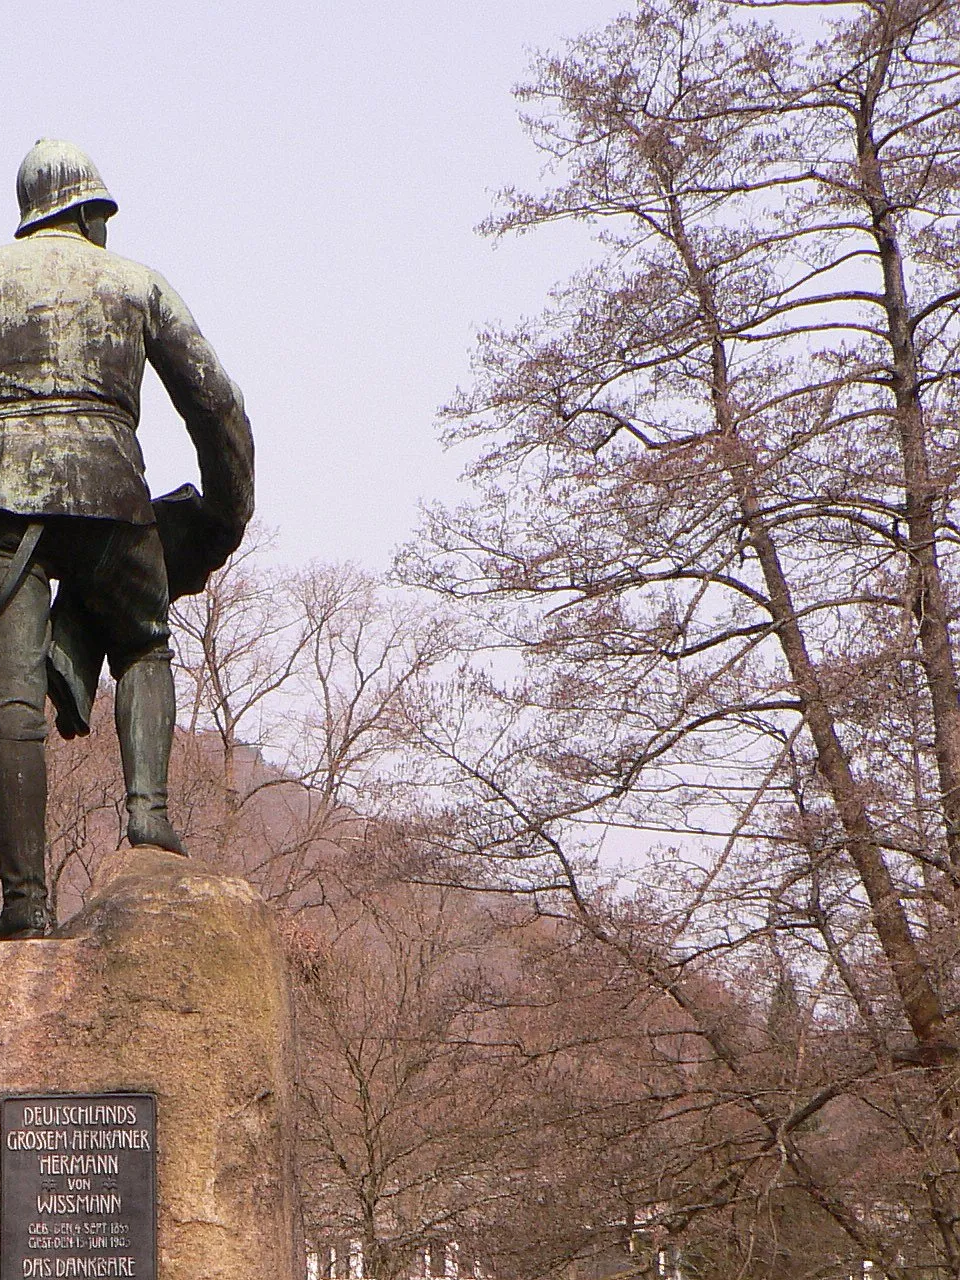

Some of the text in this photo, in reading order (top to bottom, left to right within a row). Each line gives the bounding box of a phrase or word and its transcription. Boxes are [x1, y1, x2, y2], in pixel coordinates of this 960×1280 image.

[23, 1105, 137, 1126] DEUTSCHLANDS
[72, 1130, 150, 1151] AFRIKANER
[40, 1154, 119, 1174] HERMANN
[67, 1178, 91, 1190] VON
[37, 1194, 121, 1214] WISSMANN
[23, 1257, 136, 1278] DAS DANKBARE
